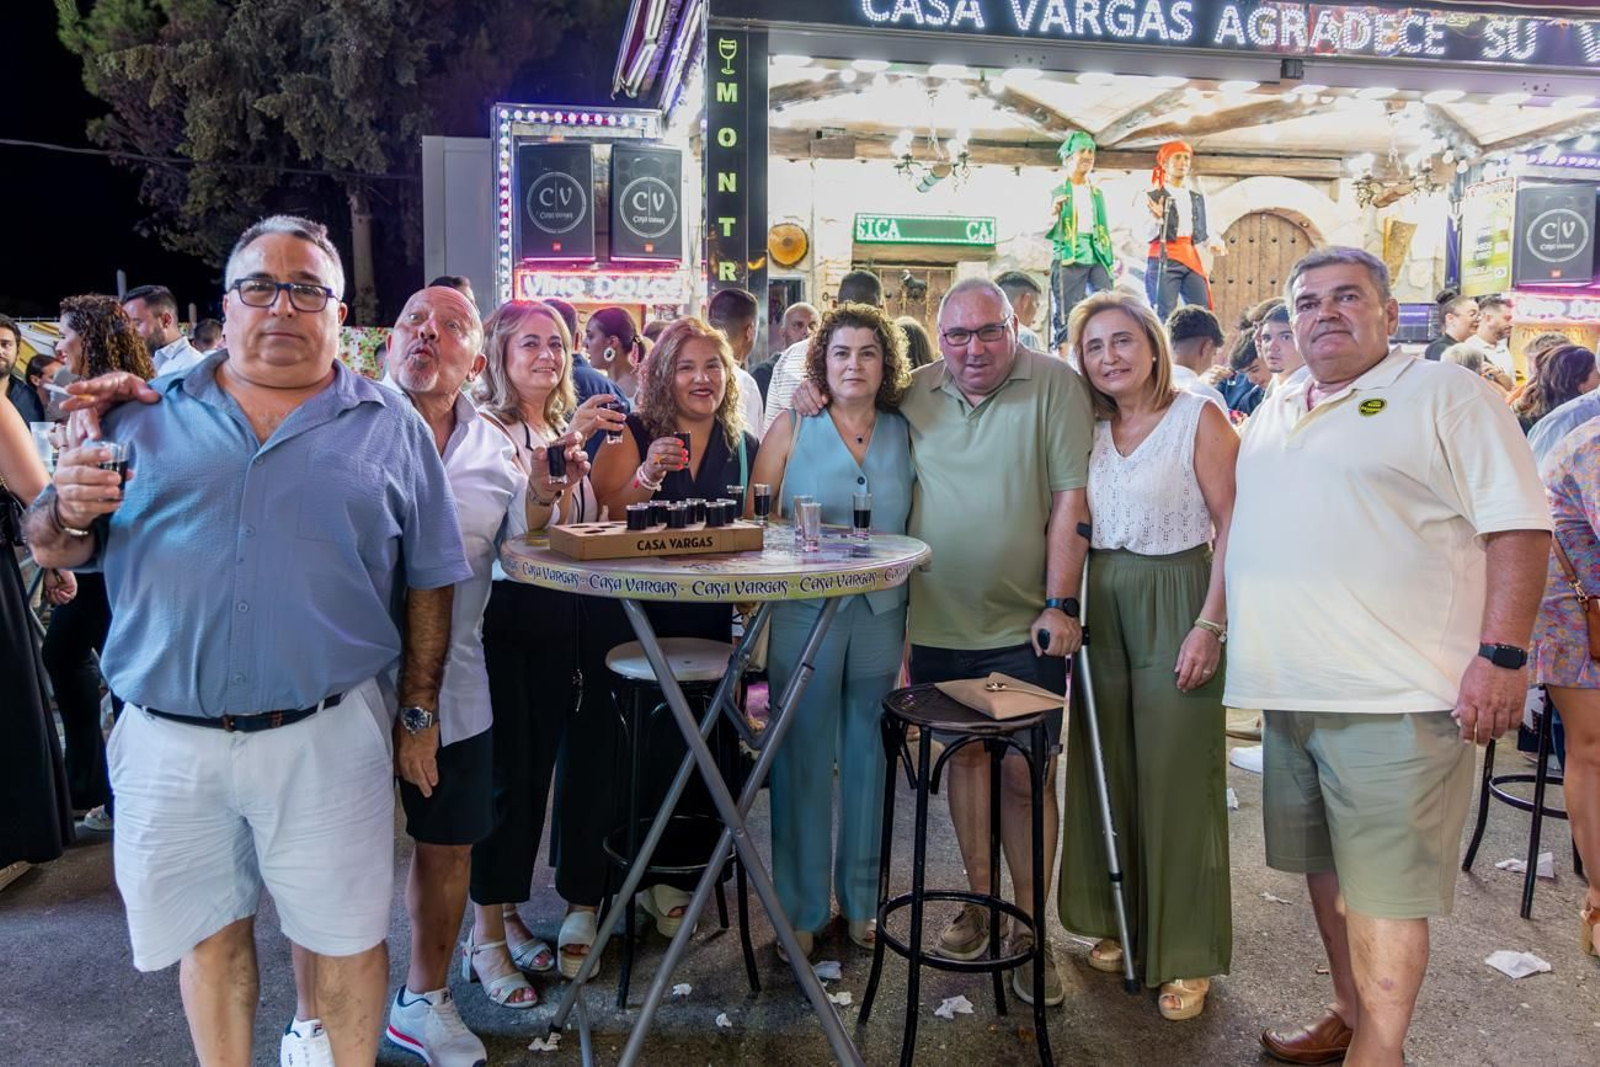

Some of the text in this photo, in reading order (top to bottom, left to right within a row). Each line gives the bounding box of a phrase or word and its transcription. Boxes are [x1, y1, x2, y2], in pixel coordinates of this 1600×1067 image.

[862, 0, 985, 28] CASA
[1011, 0, 1193, 40] VARGAS
[1213, 4, 1447, 55] AGRADECE
[1481, 18, 1539, 61] SU
[637, 536, 713, 551] CASA VARGAS
